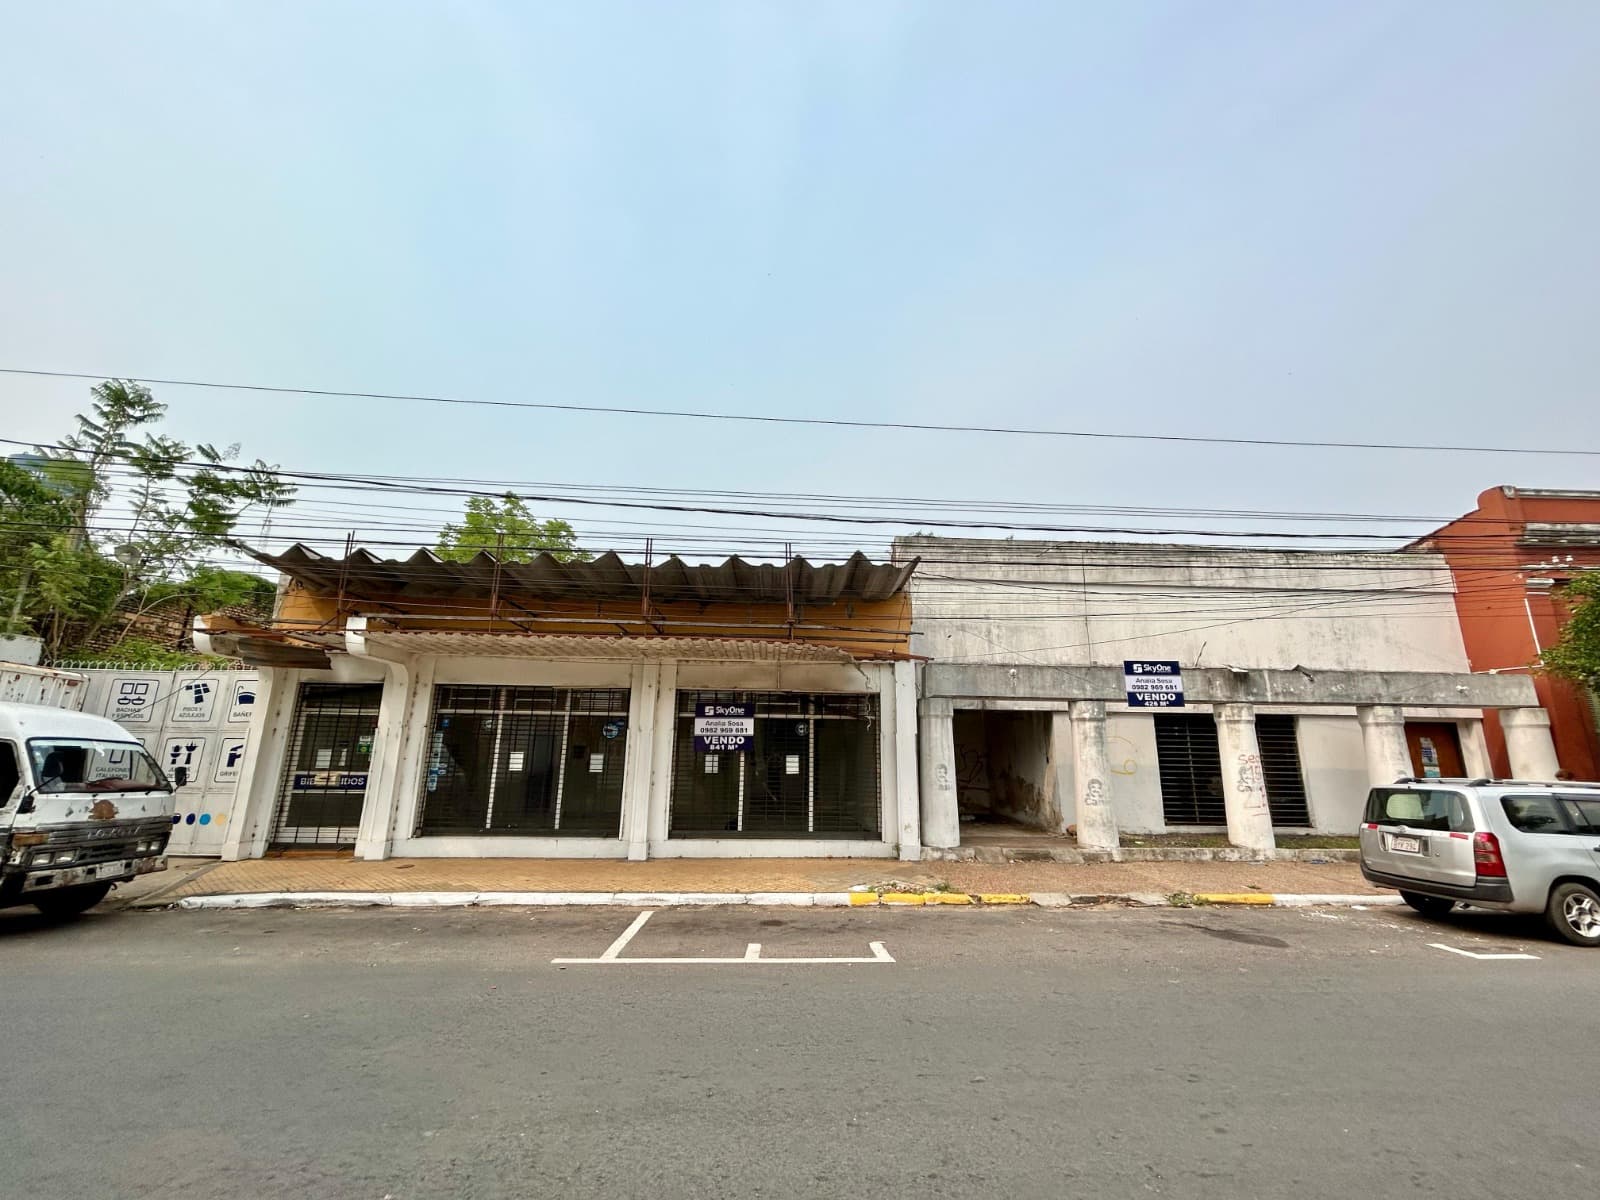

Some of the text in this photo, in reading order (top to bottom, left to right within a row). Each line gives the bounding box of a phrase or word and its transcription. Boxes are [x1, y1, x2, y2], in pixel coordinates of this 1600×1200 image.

[1143, 664, 1172, 673] SkyOne
[1136, 693, 1176, 701] VENDO
[716, 706, 745, 715] SkyOne
[704, 736, 745, 744] VENDO
[300, 777, 365, 786] BIEIDOS
